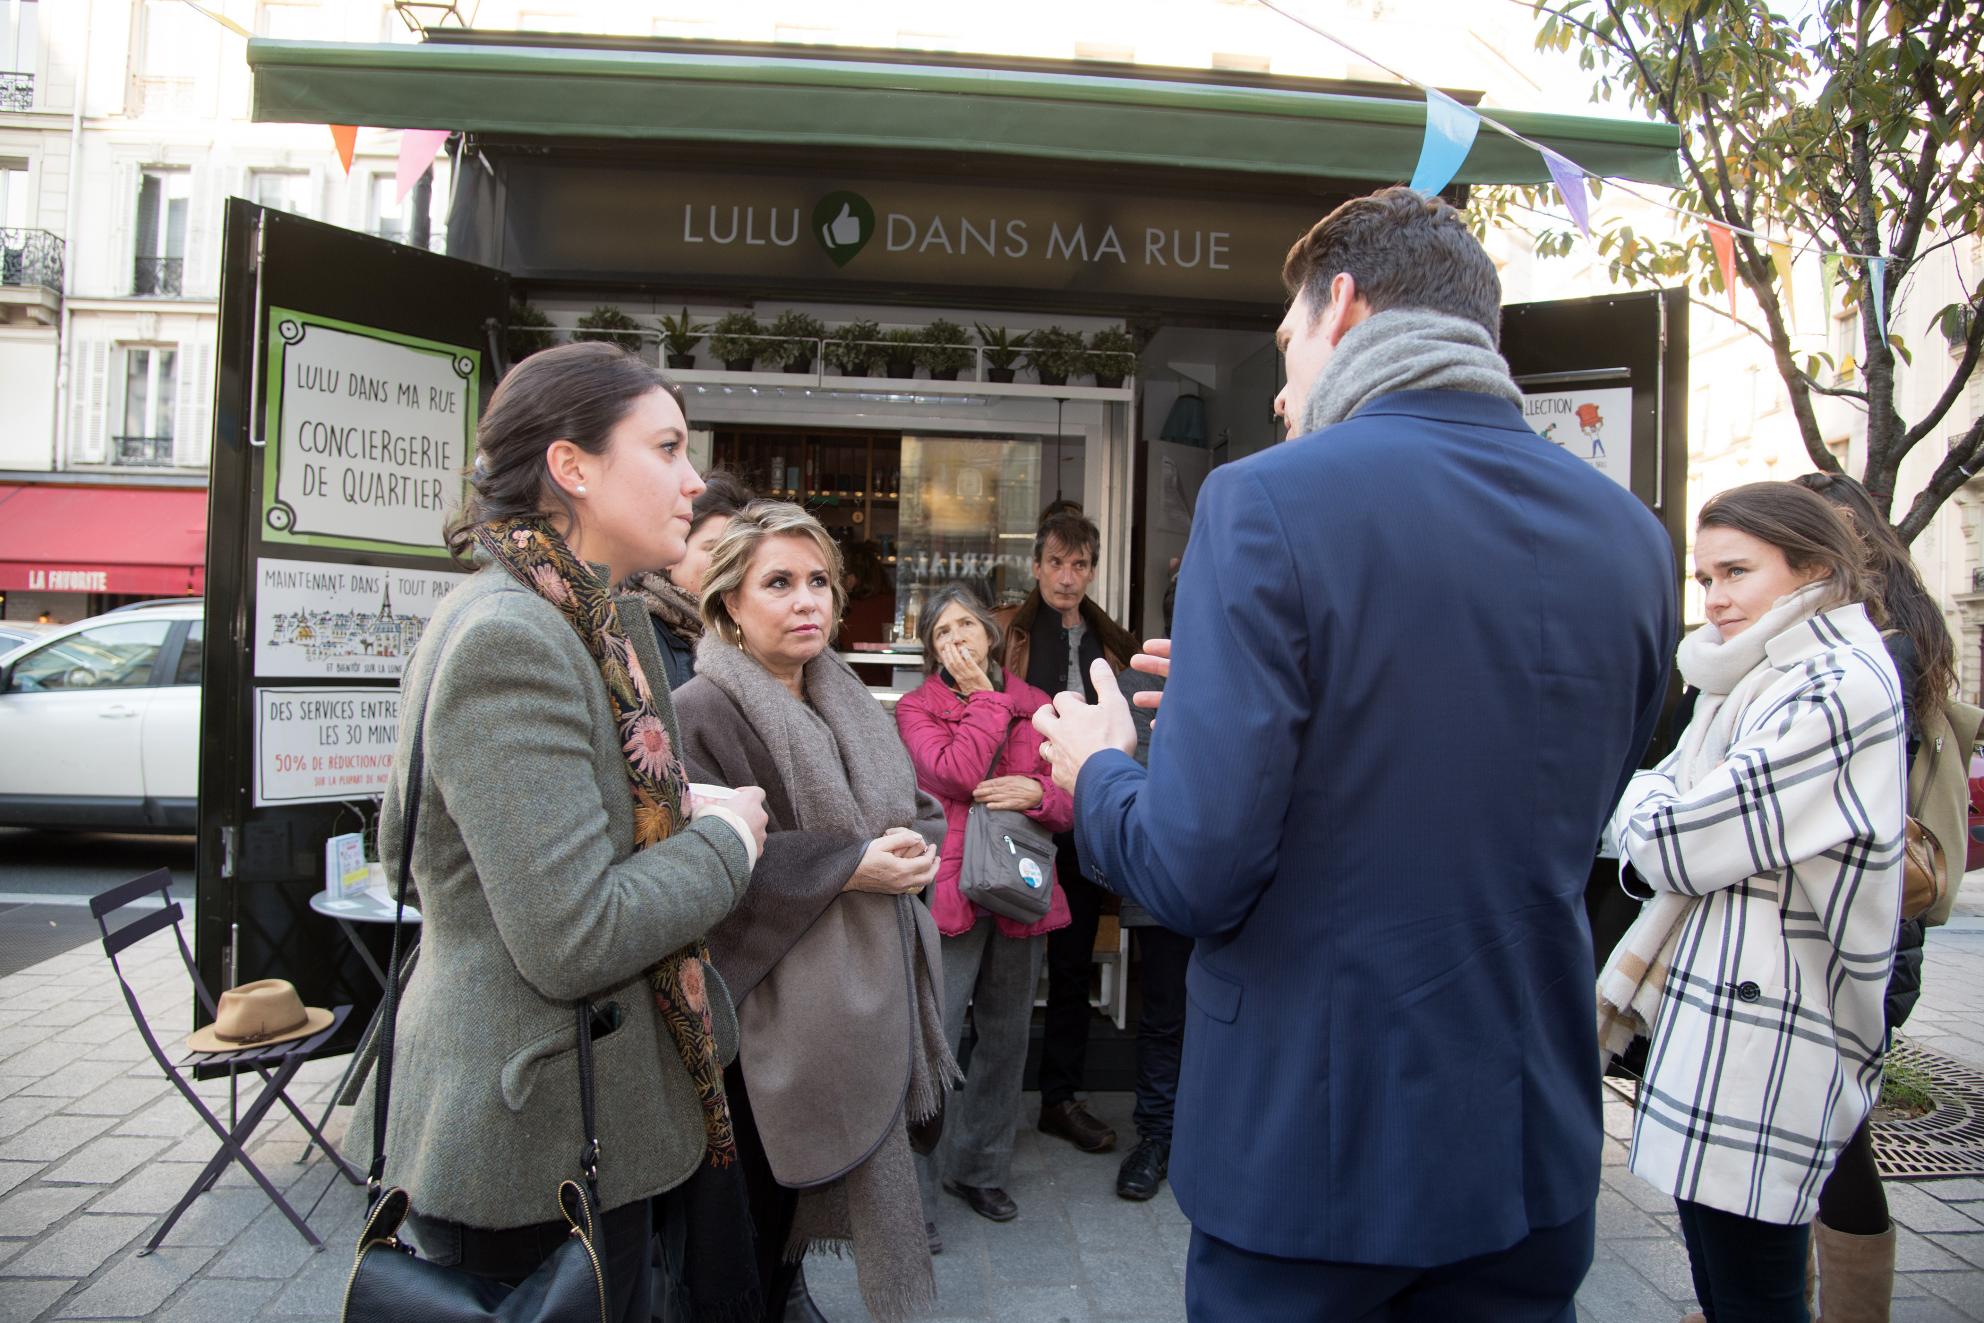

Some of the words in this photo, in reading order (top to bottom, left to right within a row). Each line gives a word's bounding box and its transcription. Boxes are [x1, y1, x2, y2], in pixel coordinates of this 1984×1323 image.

[684, 204, 800, 246] LULU
[886, 213, 1029, 258] DANS
[1046, 222, 1127, 264] MA
[1145, 227, 1230, 270] RUE
[297, 363, 339, 394] LULU
[348, 372, 389, 403] DANS
[397, 383, 420, 410] MA
[429, 386, 456, 414] RUE
[298, 420, 451, 471] CONCIERGERIE
[303, 463, 328, 497] DE
[343, 467, 444, 511] QUARTIER
[29, 569, 45, 590] LA
[48, 570, 107, 591] FAVORITE
[264, 570, 344, 594] MAINTENANT
[351, 575, 380, 594] DANS
[398, 578, 426, 596] TOUT
[432, 580, 459, 598] PARI
[326, 662, 333, 672] ET
[270, 701, 293, 721] DES
[300, 700, 354, 721] SERVICES
[361, 700, 398, 719] ENTRE
[319, 725, 339, 745] LES
[346, 724, 362, 745] 30
[275, 754, 307, 772] 50%
[312, 756, 322, 771] DE
